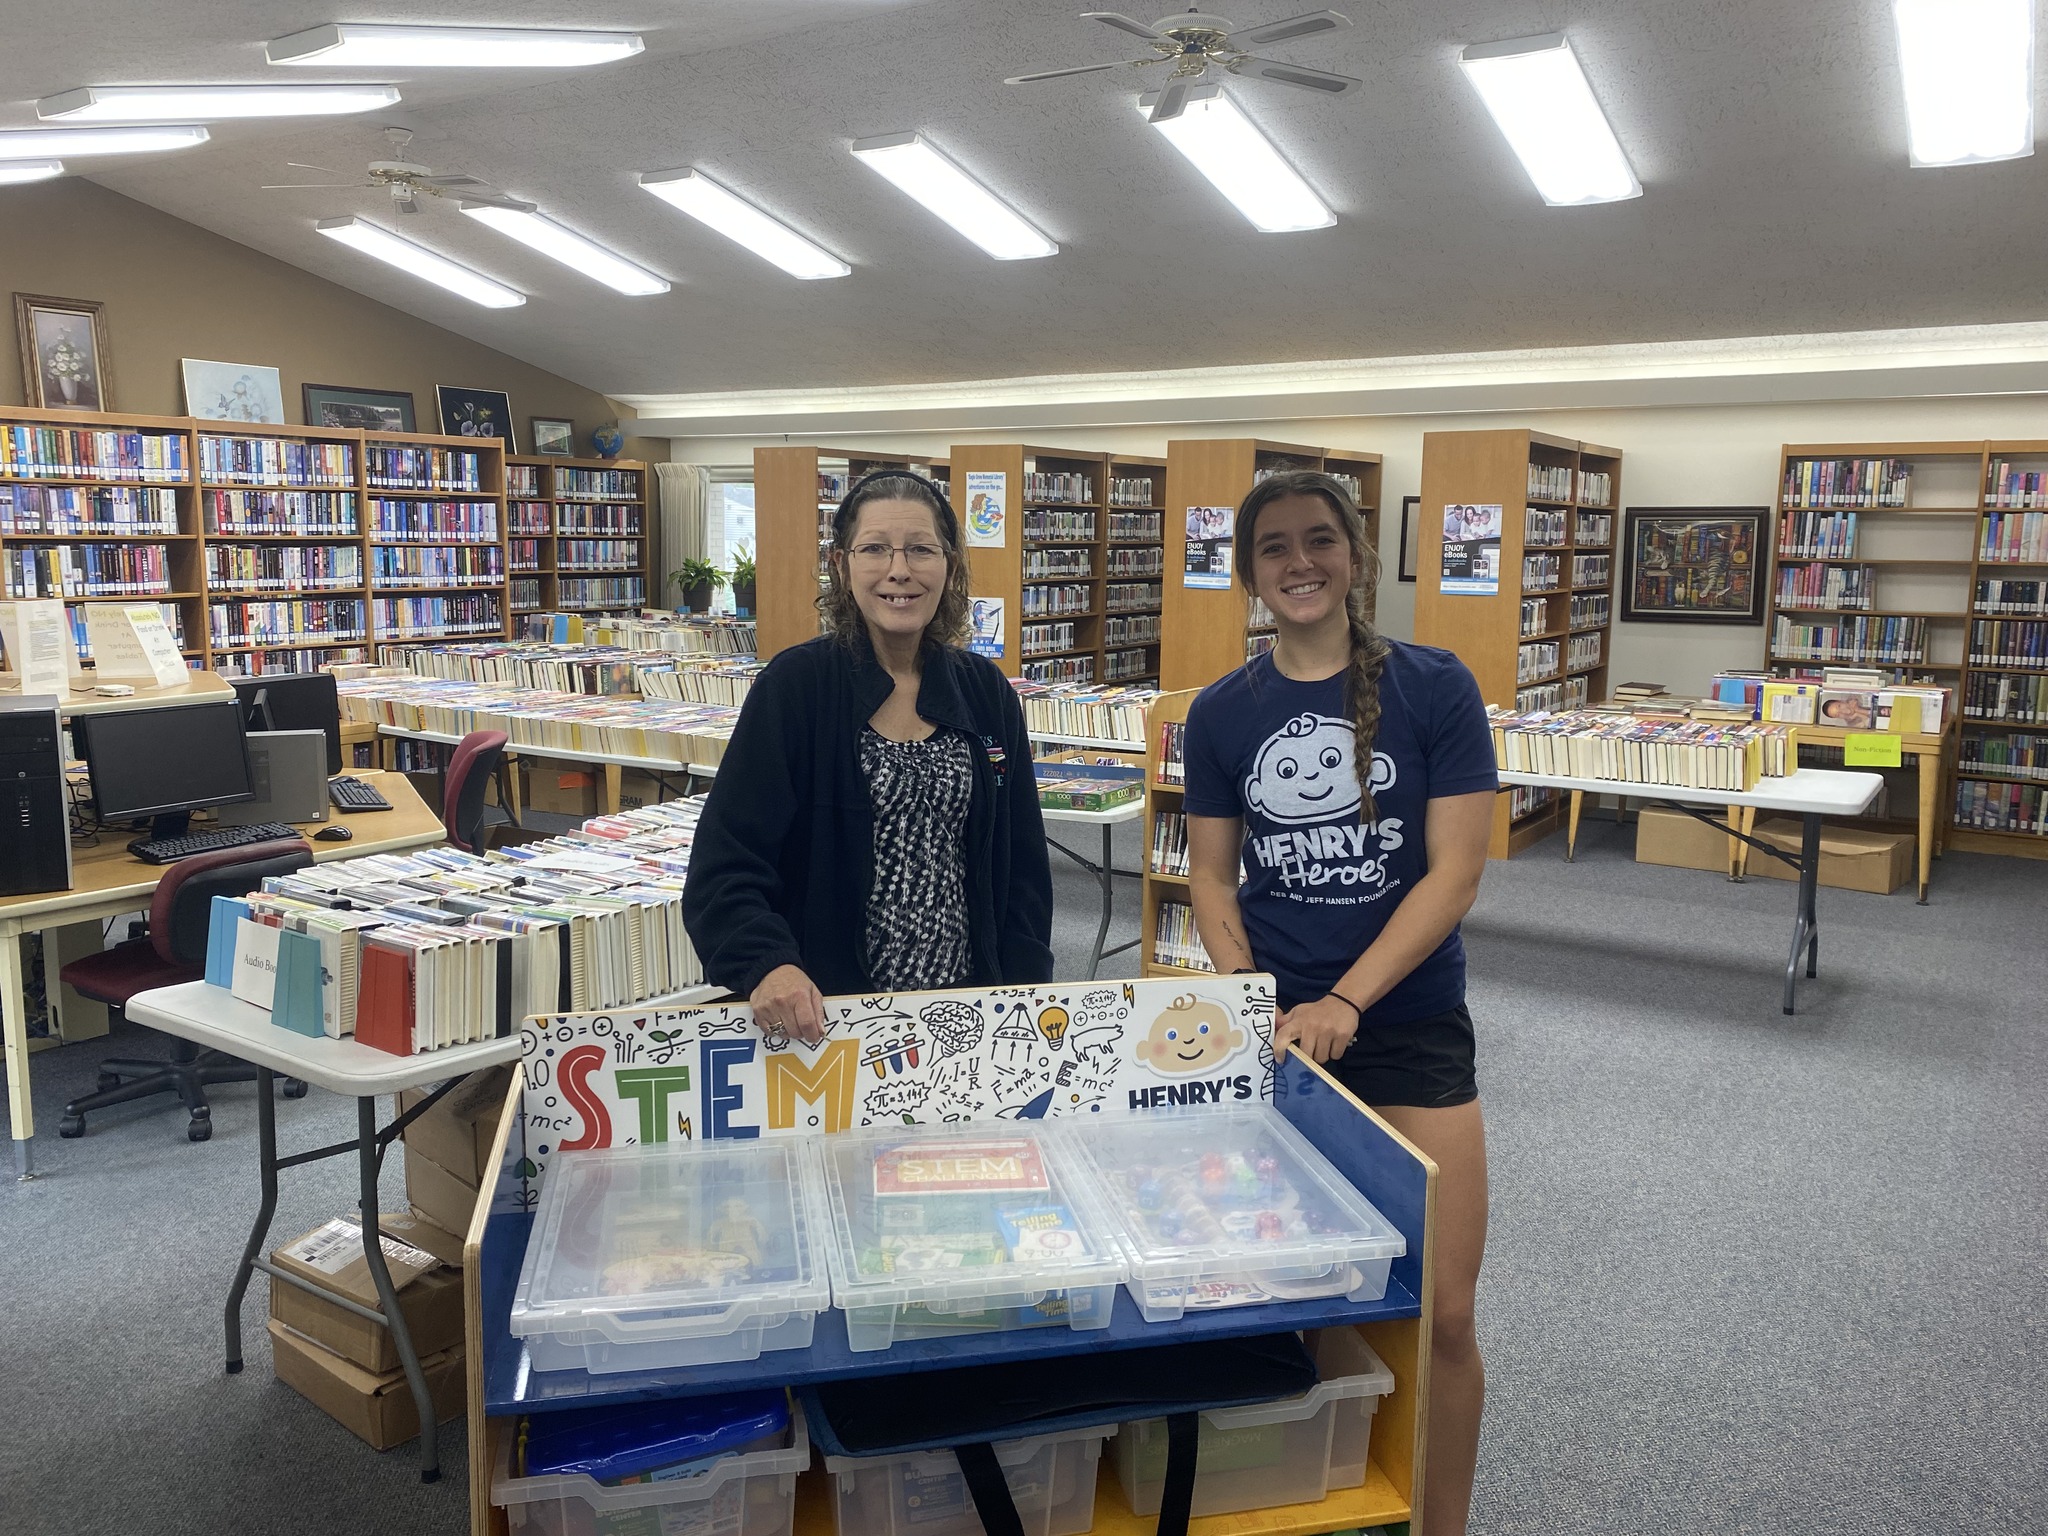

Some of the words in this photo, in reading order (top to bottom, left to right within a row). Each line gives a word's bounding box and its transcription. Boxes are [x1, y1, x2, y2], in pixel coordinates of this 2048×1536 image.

[1187, 542, 1204, 550] ENJOY
[1445, 544, 1465, 552] ENJOY
[1444, 551, 1467, 559] eBooks
[1853, 746, 1892, 754] Non-Fiction
[1117, 788, 1130, 799] 1000
[1253, 817, 1404, 868] HENRY'S
[1279, 852, 1389, 888] Heroes
[1289, 892, 1303, 902] AND
[1305, 896, 1324, 904] JEFF
[1325, 897, 1356, 905] HANSEN
[244, 953, 264, 969] Audio
[265, 957, 276, 974] Boo
[557, 1039, 861, 1151] STEM
[1128, 1074, 1252, 1110] HENRY'S
[904, 1156, 1017, 1175] STEM
[903, 1173, 1020, 1183] CHALLENGES
[1010, 1212, 1057, 1228] Telling
[1030, 1218, 1063, 1232] Time
[1199, 1431, 1263, 1448] MAGNETI
[610, 1509, 642, 1522] CENTER
